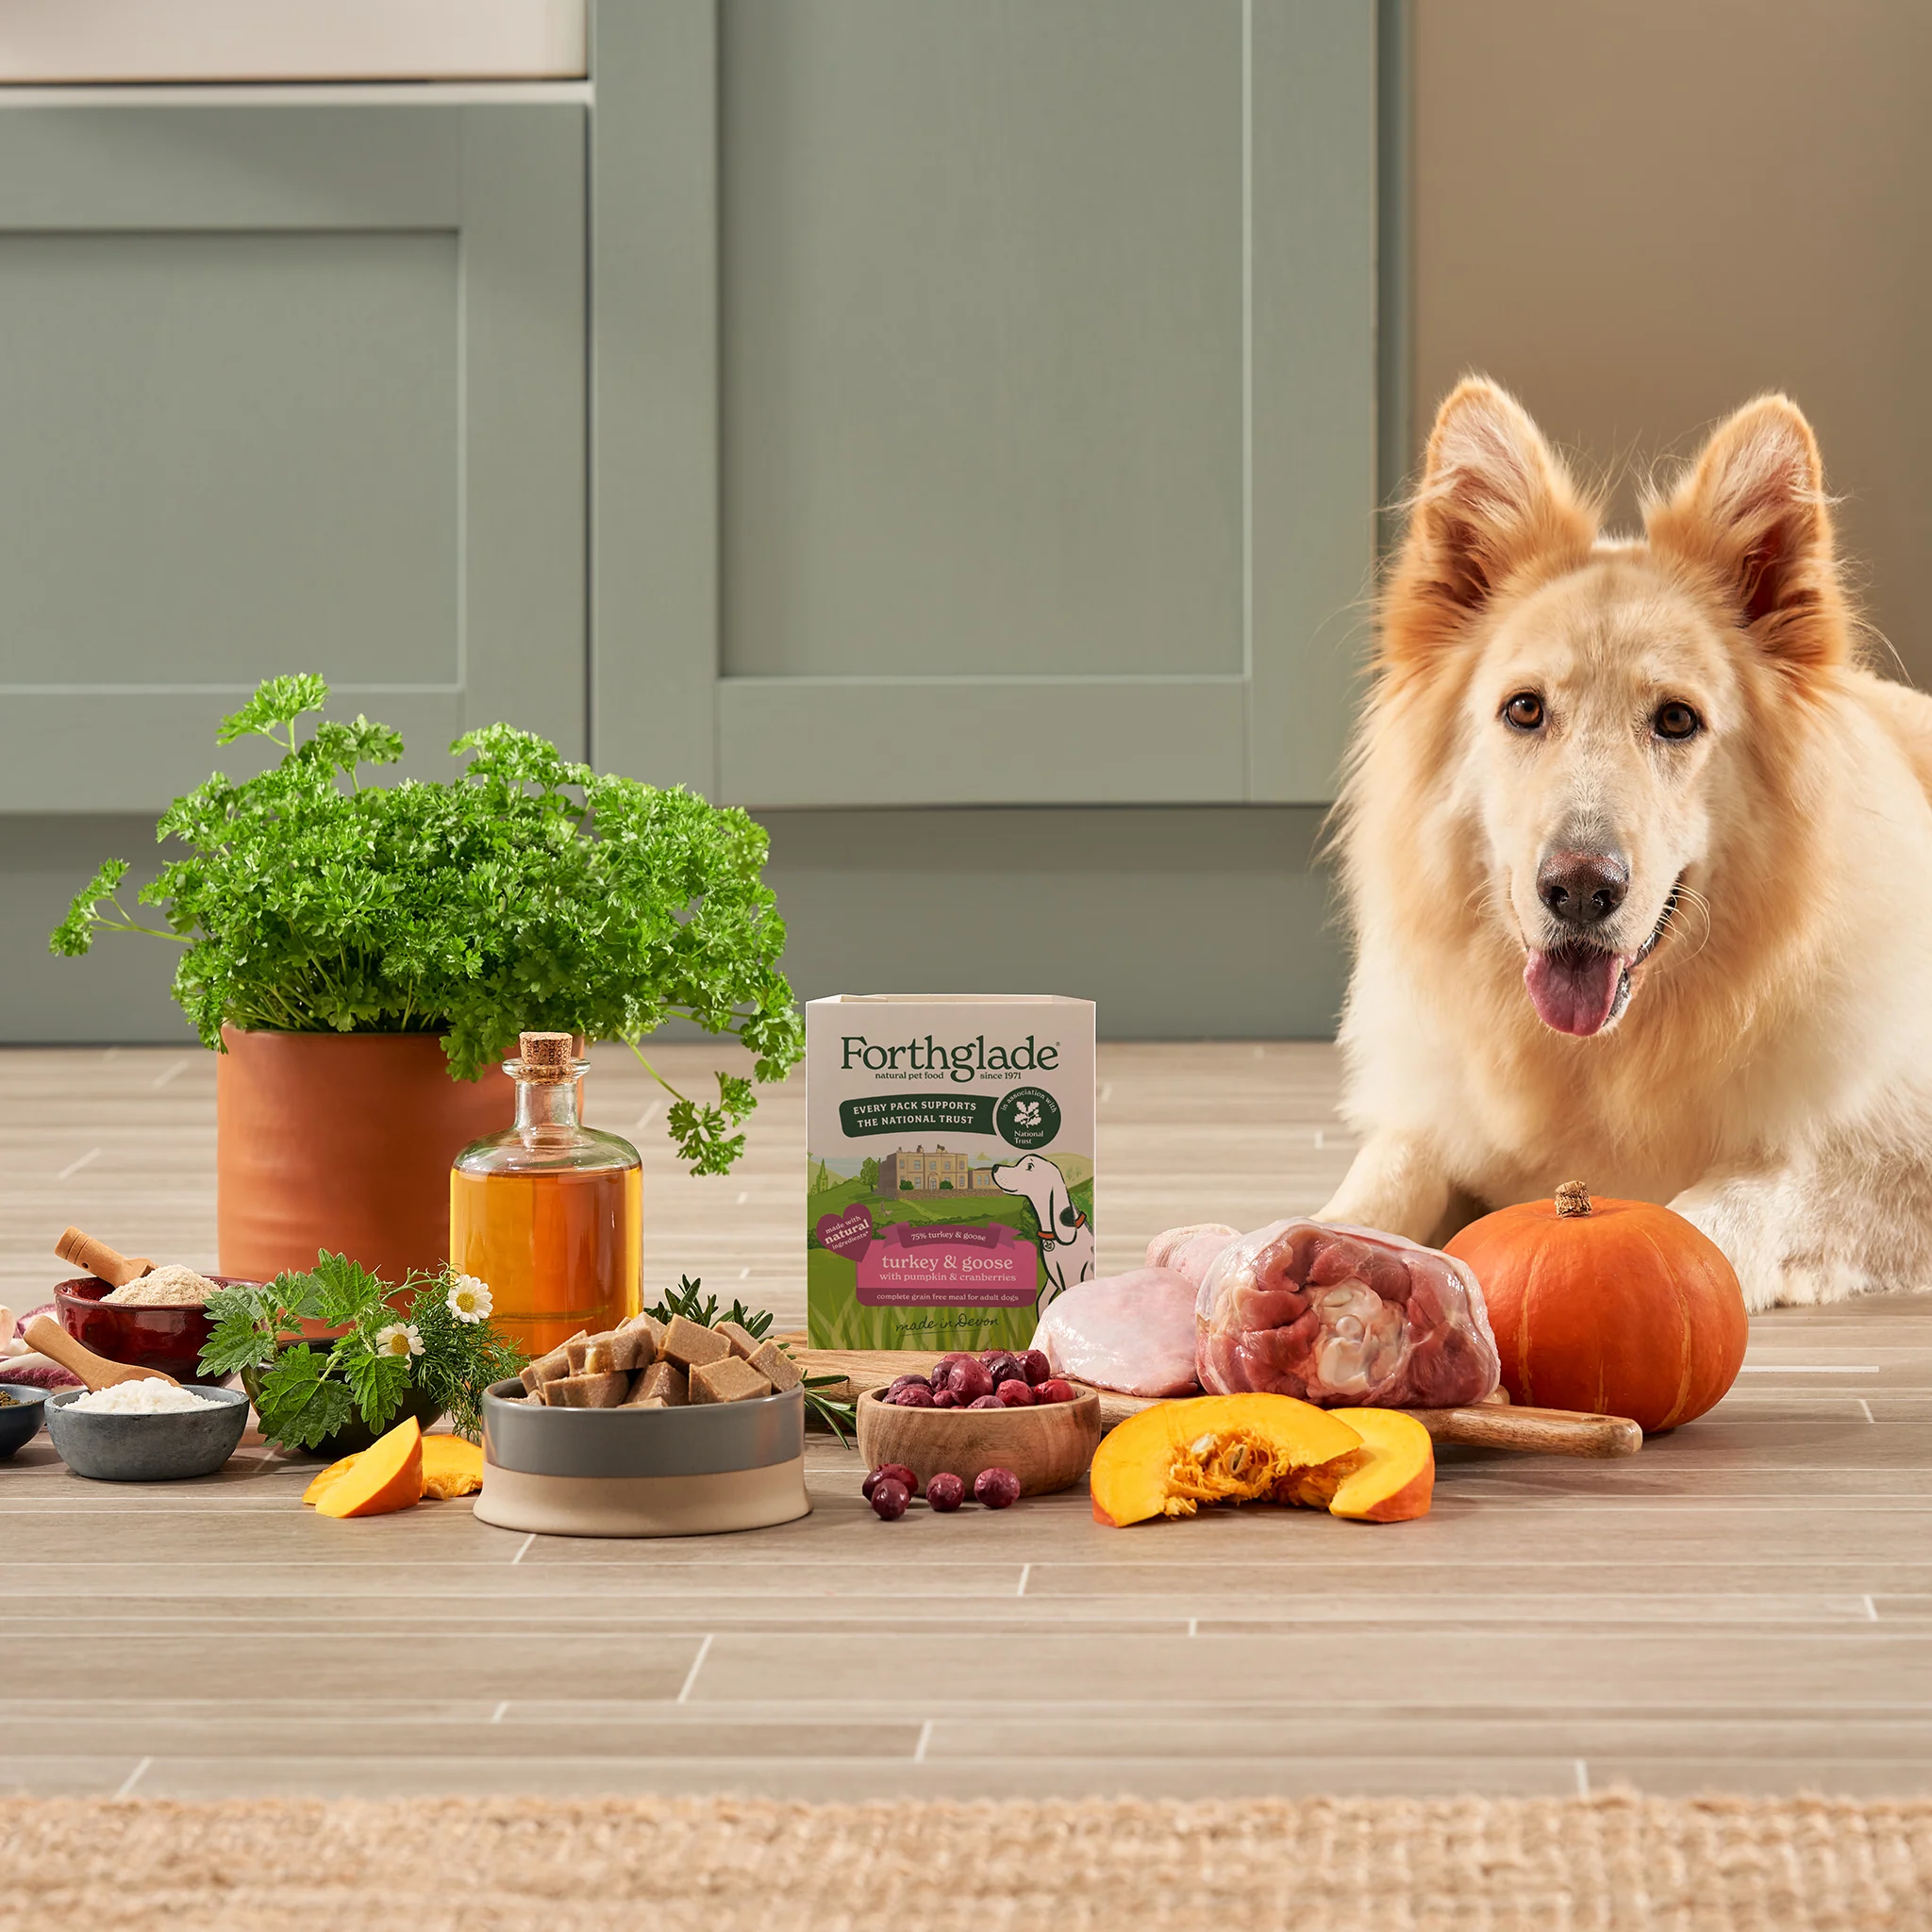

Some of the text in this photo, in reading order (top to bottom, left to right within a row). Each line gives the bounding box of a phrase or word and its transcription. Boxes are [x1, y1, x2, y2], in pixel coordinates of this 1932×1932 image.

[908, 1072, 924, 1081] pet
[980, 1072, 1003, 1080] since
[1005, 1072, 1022, 1080] 1971
[853, 1101, 976, 1115] EVERY PACK SUPPORTS
[1007, 1089, 1045, 1104] association
[1045, 1097, 1058, 1113] with
[858, 1115, 974, 1128] THE NATIONAL TRUST
[824, 1218, 870, 1244] natural
[825, 1215, 861, 1234] made with
[963, 1233, 986, 1241] goose
[882, 1254, 1013, 1273] turkey & goose
[879, 1273, 1016, 1282] with pumpkin & cranberries
[876, 1293, 910, 1302] complete
[1001, 1293, 1019, 1302] dogs
[895, 1313, 998, 1332] made in Devon
